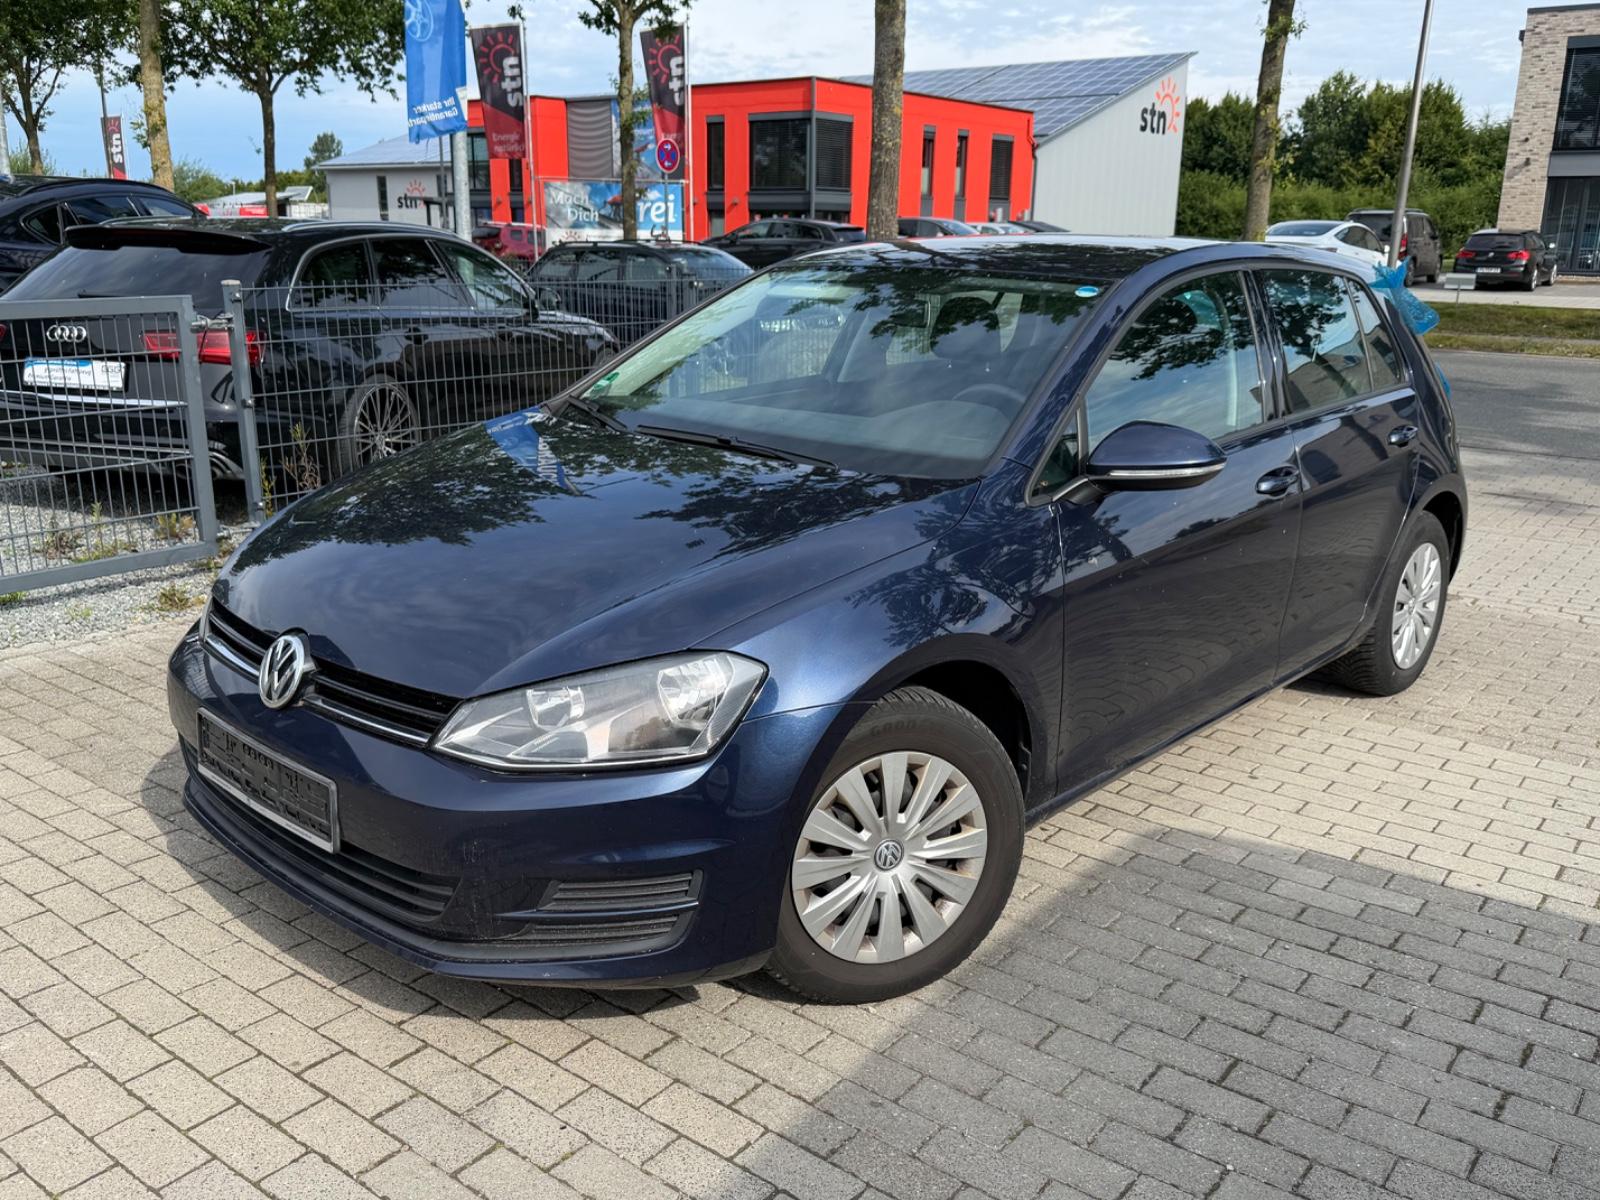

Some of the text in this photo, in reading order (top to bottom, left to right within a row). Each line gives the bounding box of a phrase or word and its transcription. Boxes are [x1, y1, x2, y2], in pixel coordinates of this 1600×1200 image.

[502, 56, 523, 107] stn
[1140, 102, 1167, 135] stn
[111, 133, 123, 163] stn
[397, 193, 418, 209] stn
[567, 207, 599, 222] Dich
[637, 194, 676, 223] rei
